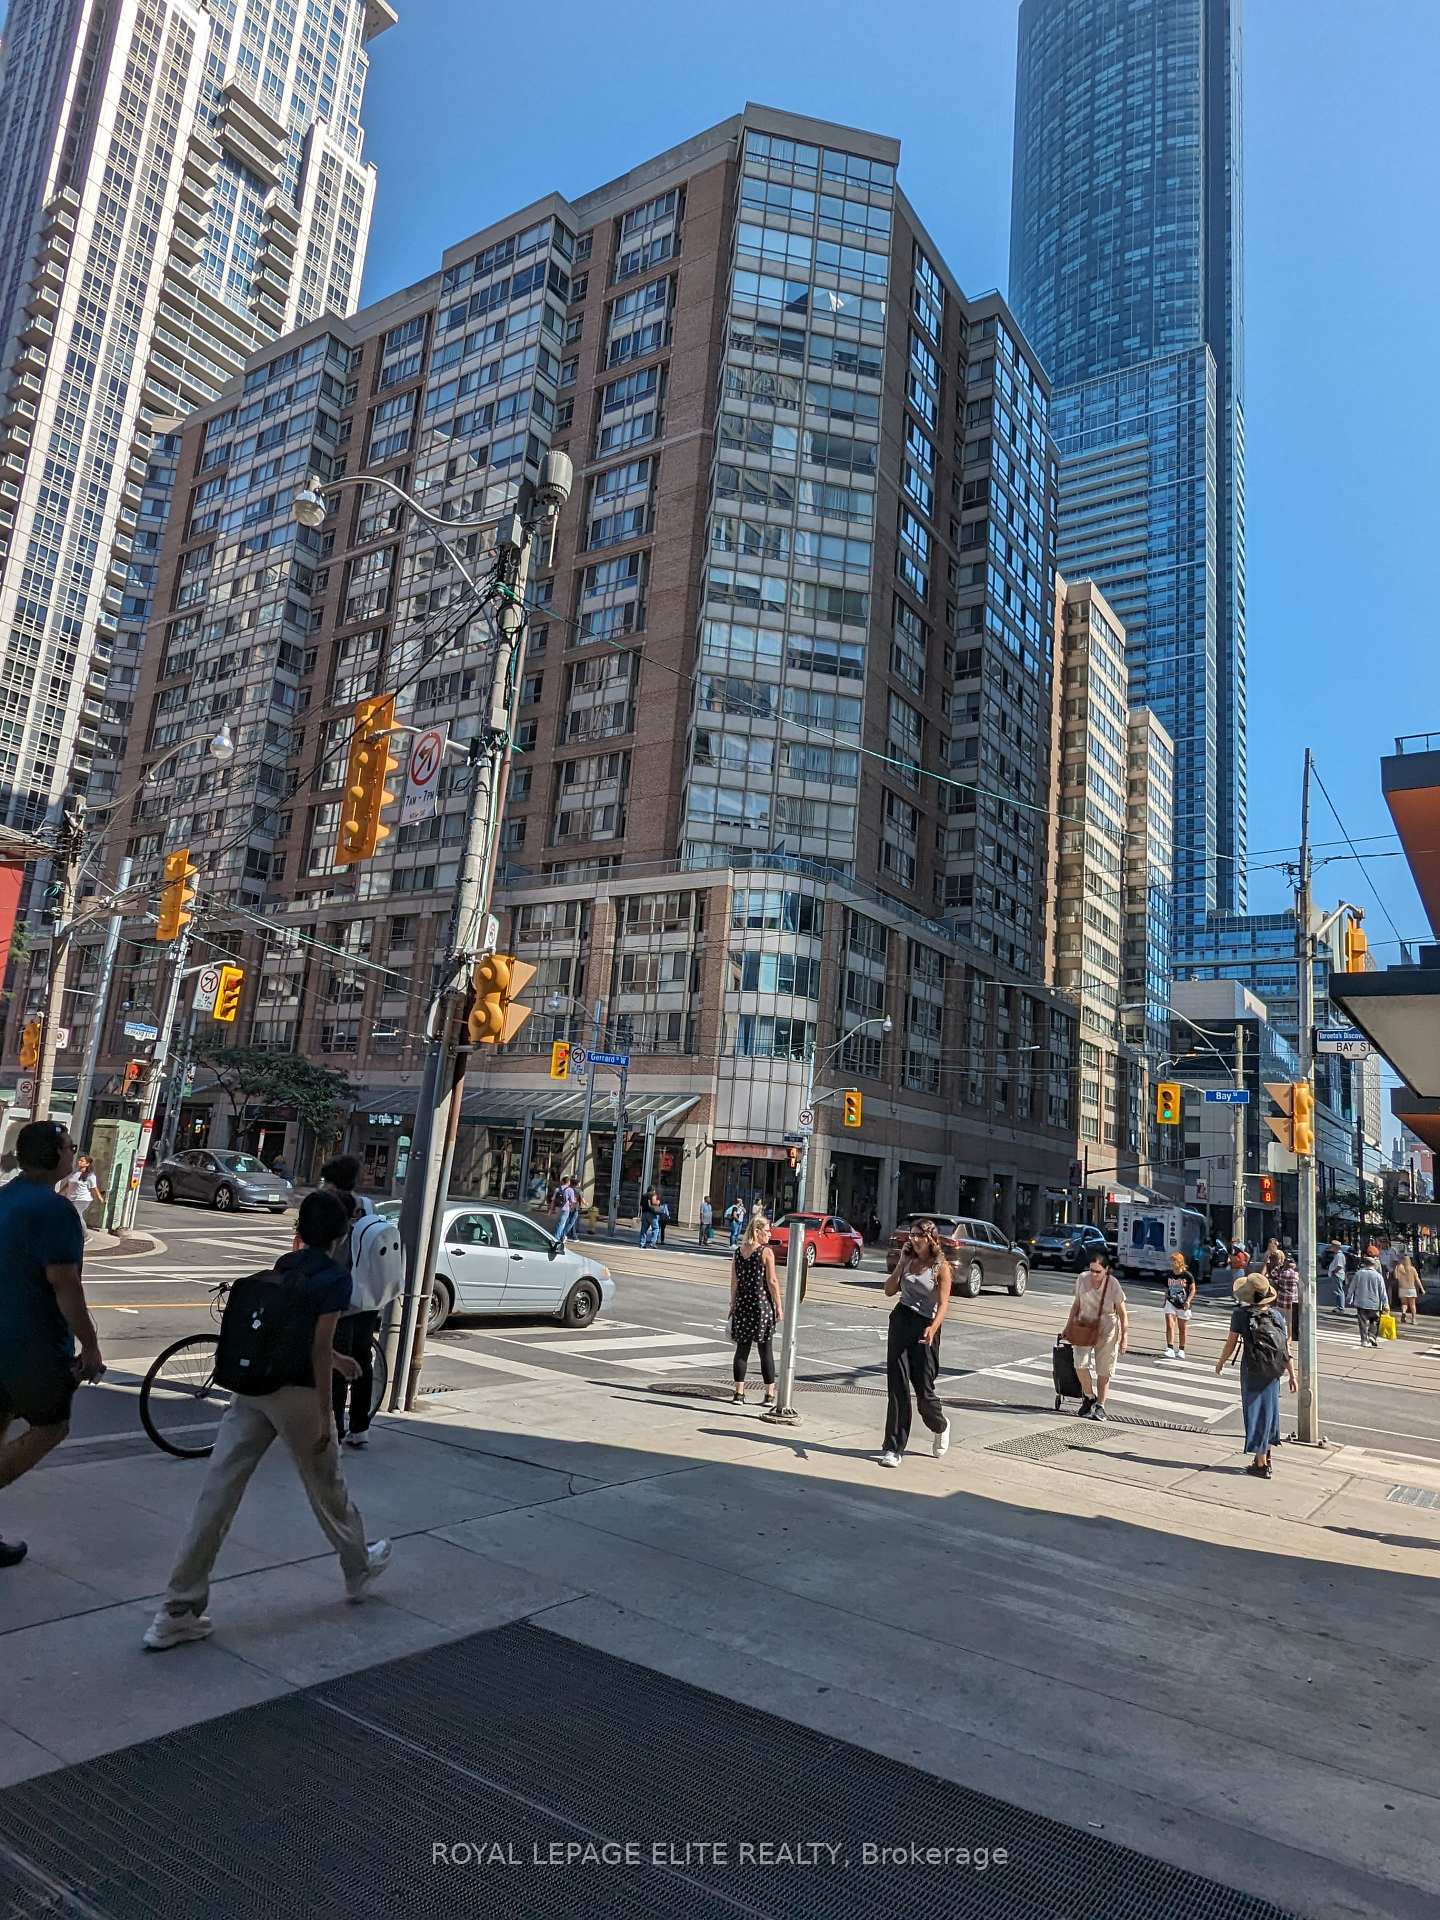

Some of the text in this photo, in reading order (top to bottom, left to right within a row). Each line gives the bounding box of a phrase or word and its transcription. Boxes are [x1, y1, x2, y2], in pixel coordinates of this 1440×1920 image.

[1336, 1042, 1354, 1051] BAY
[590, 1053, 615, 1063] Gerrard
[1215, 1091, 1232, 1102] Bay
